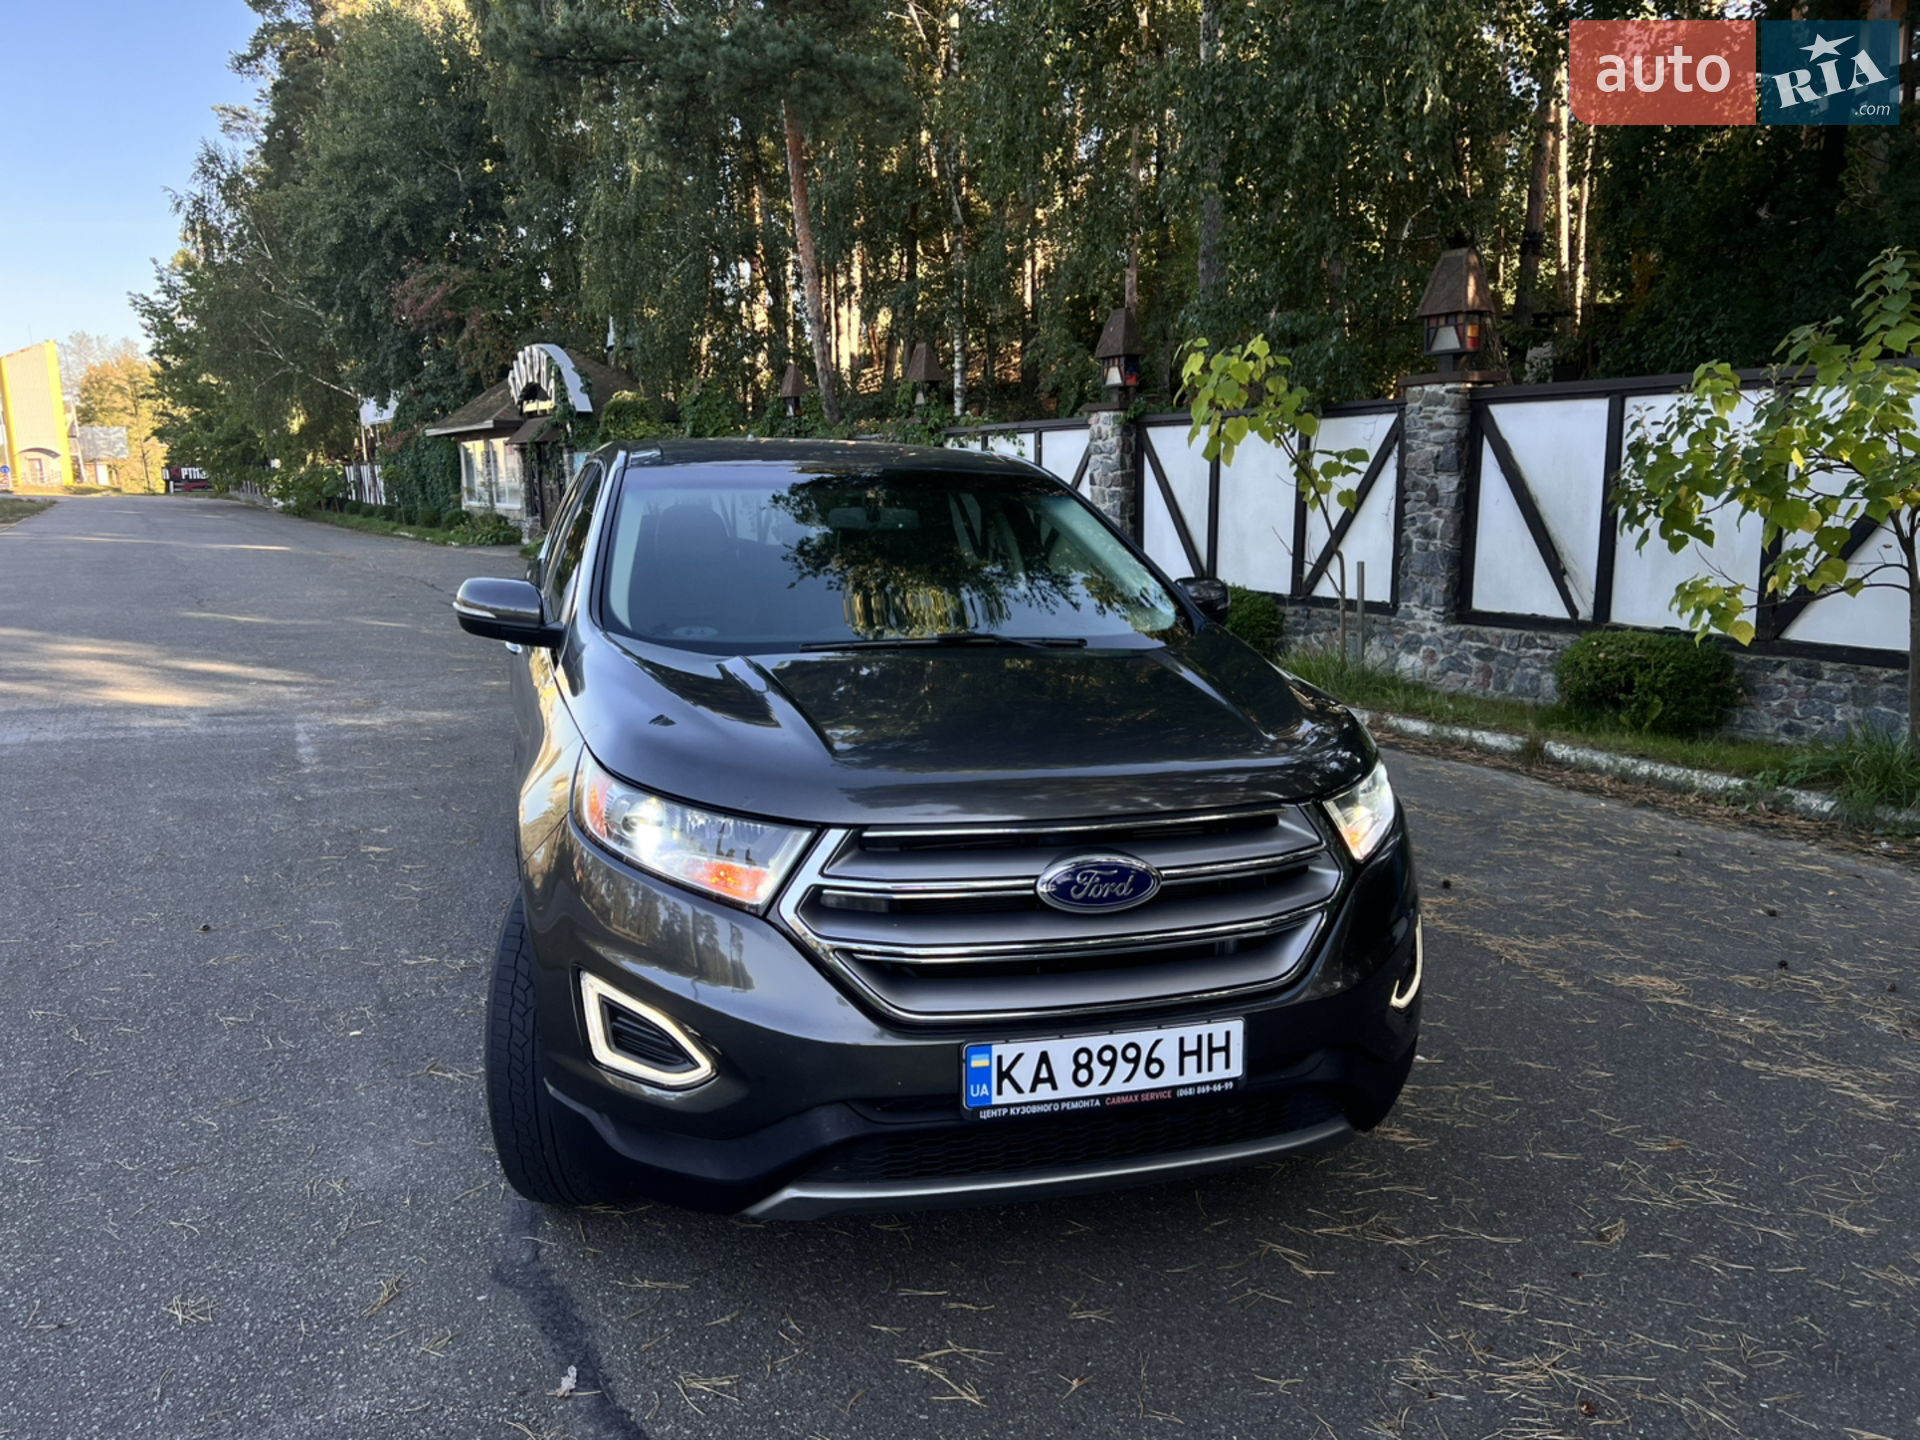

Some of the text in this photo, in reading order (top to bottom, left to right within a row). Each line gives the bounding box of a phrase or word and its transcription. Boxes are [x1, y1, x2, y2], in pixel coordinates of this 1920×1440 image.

[1070, 869, 1135, 899] Ford
[996, 1030, 1231, 1096] KA 8996 HH
[970, 1083, 989, 1098] UA
[979, 1108, 1008, 1119] ЦЕНТР
[1009, 1103, 1060, 1115] КУЗОВНОГО
[1060, 1099, 1101, 1110] РЕМОНТА
[1105, 1095, 1139, 1105] CARMAX
[1140, 1090, 1172, 1101] SERVICE
